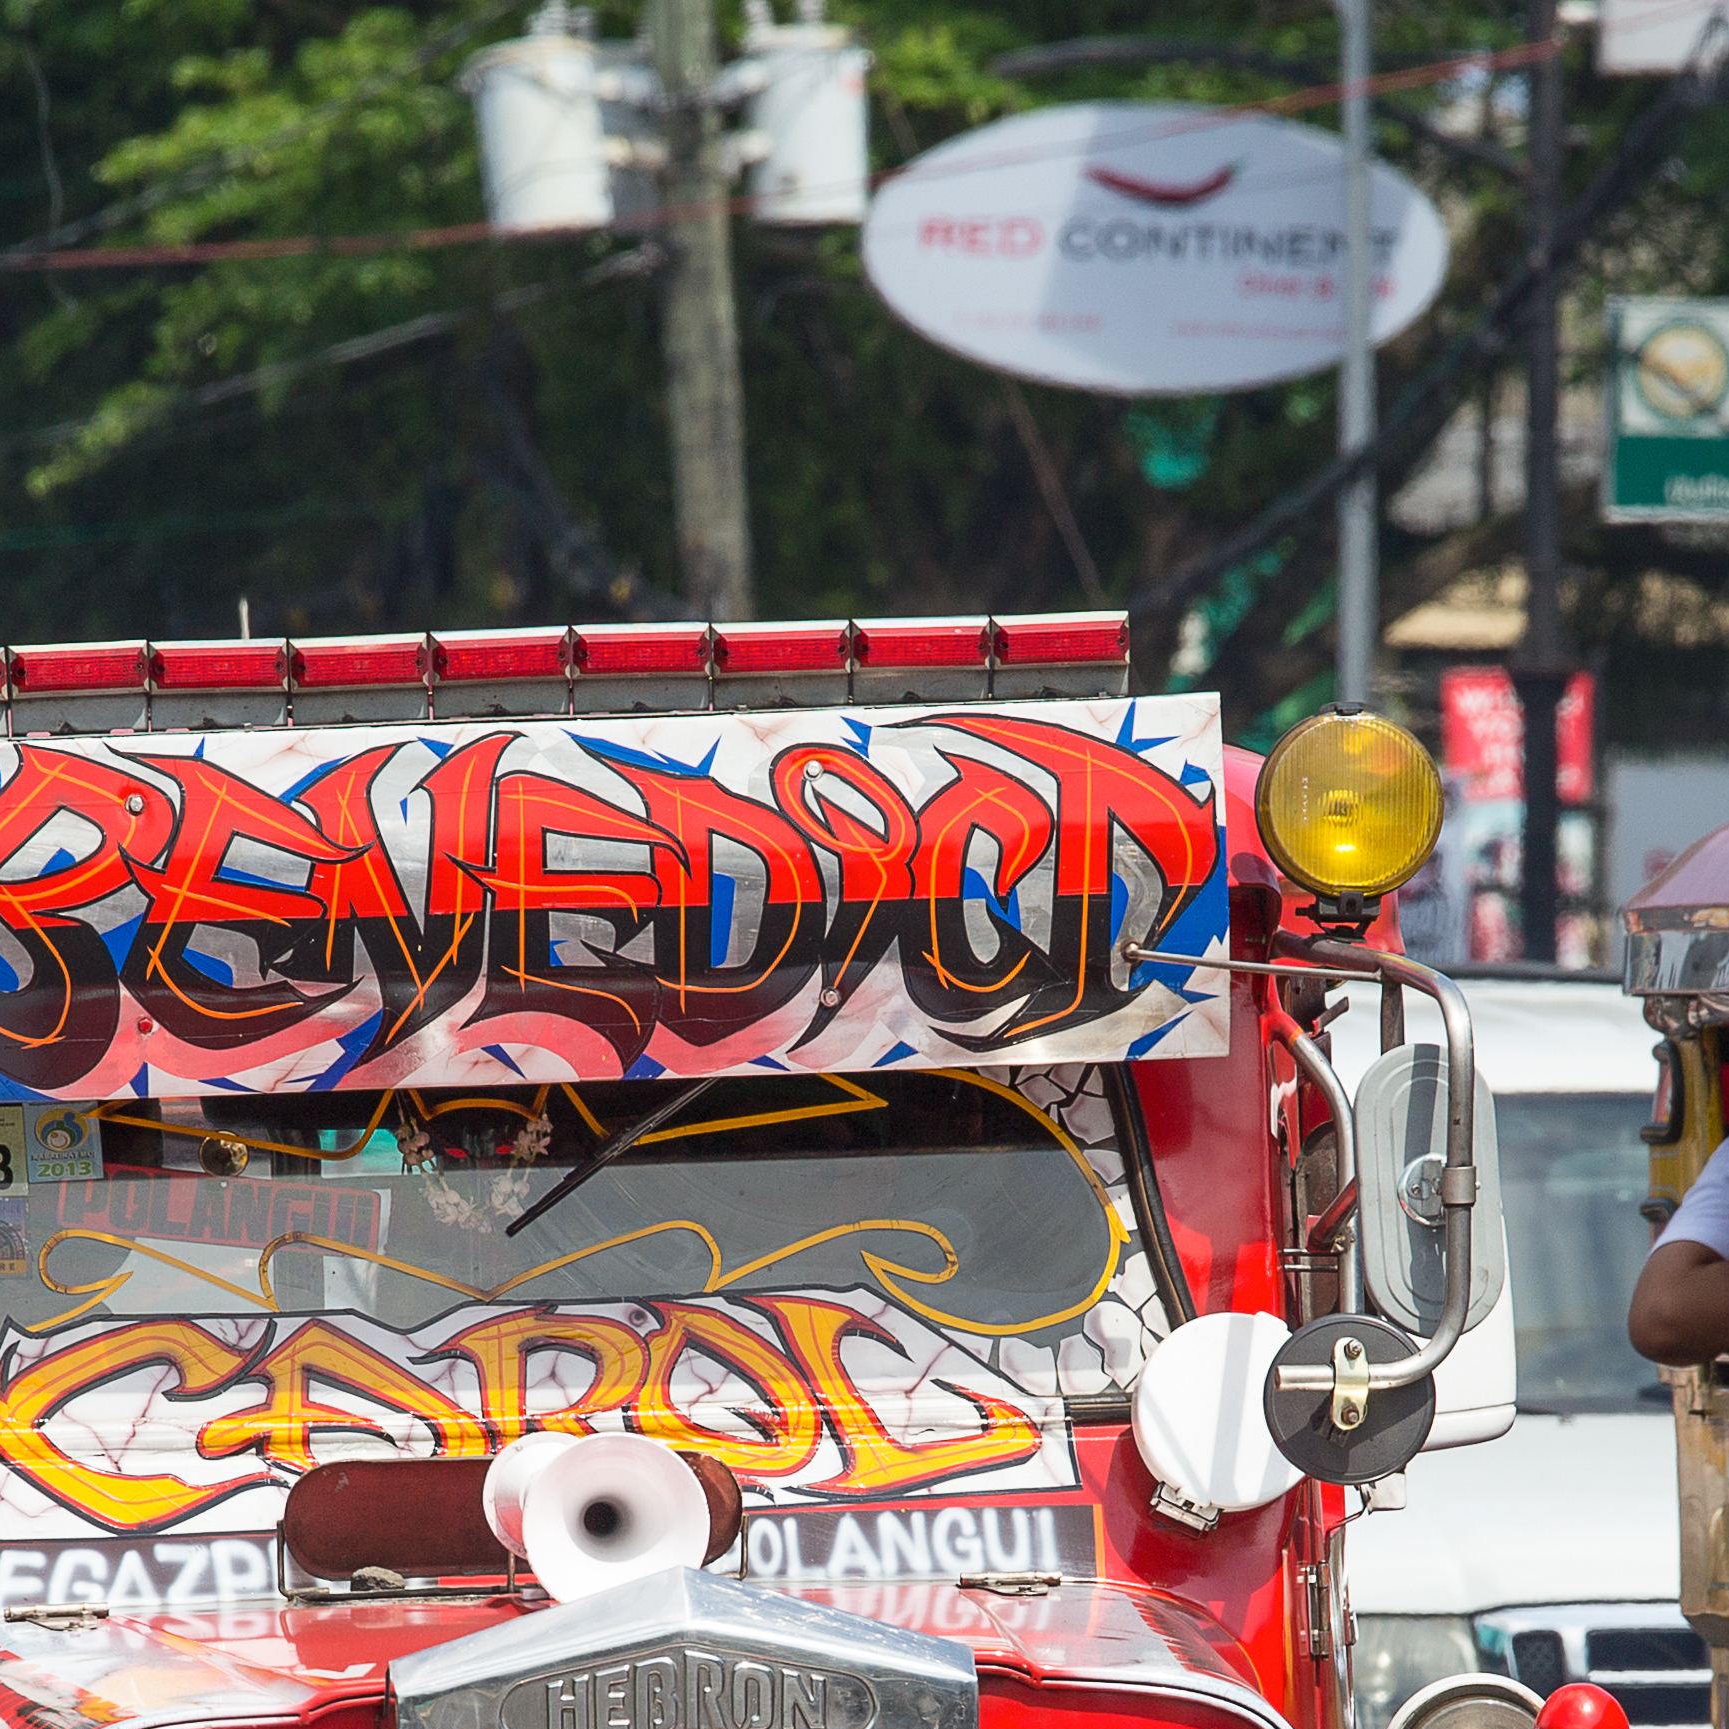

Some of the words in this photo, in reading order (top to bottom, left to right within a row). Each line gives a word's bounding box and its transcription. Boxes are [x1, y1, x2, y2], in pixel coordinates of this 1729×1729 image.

[918, 216, 1044, 258] RED
[37, 1161, 93, 1177] 2013
[61, 1168, 373, 1252] POLANGUI
[711, 1506, 1061, 1580] OLANGUI
